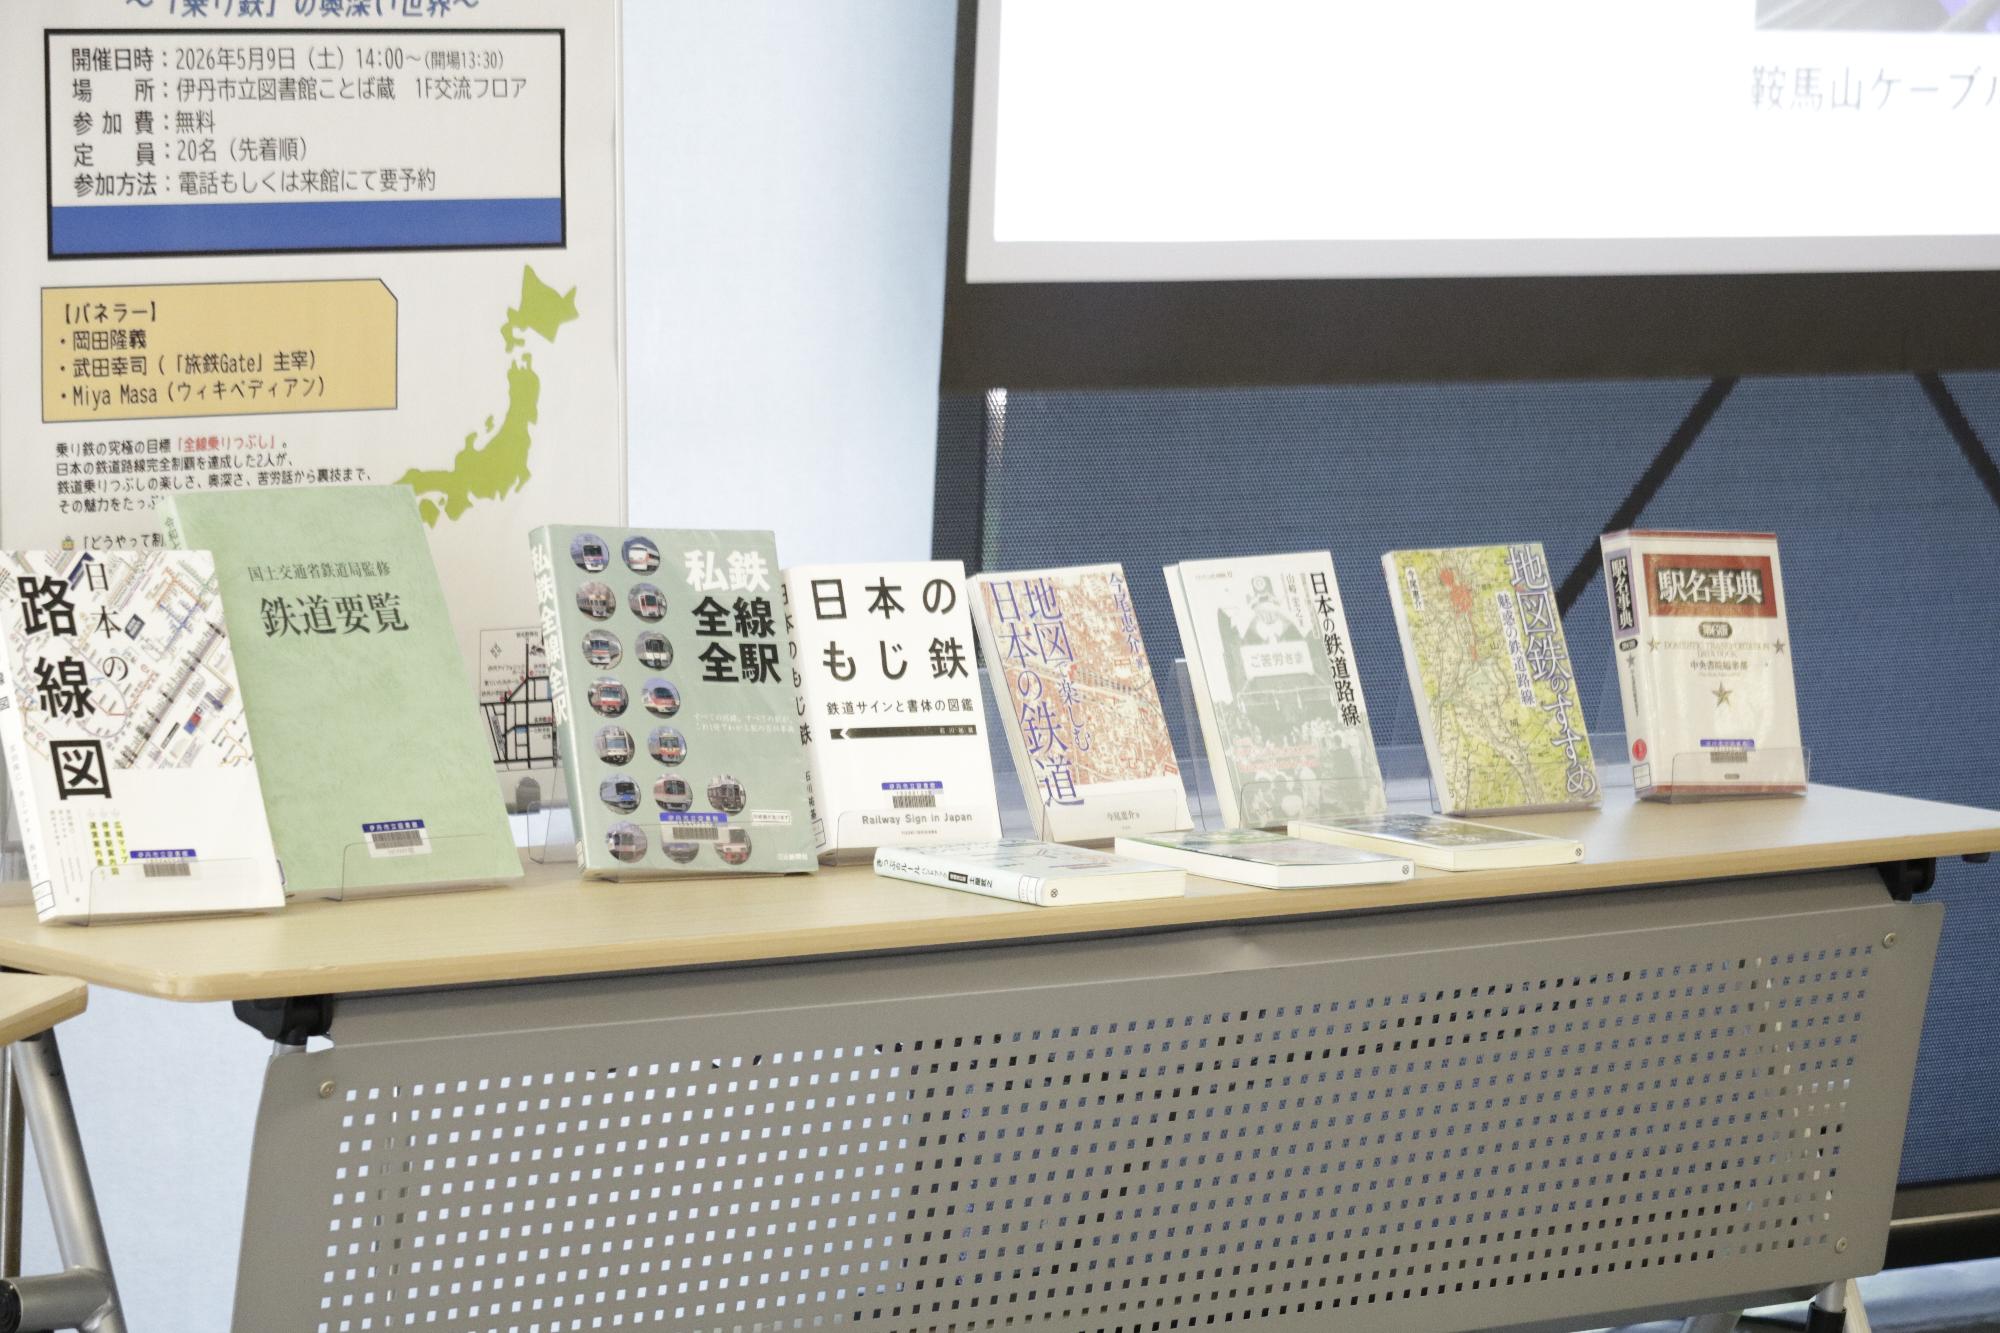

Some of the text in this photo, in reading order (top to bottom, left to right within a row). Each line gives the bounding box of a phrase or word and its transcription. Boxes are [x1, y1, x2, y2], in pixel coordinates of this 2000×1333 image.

[247, 560, 391, 582] 国土交通省鉄道局監修
[683, 550, 771, 593] 私鉄
[1610, 557, 1634, 630] 駅名事典
[1658, 569, 1763, 604] 駅名事典
[259, 592, 409, 638] 鉄道要覧
[691, 596, 776, 639] 全線
[810, 576, 957, 621] 日本の
[85, 563, 129, 681] 日本の
[700, 642, 782, 684] 全駅
[822, 637, 969, 683] もじ鉄
[1023, 577, 1091, 751] 地図で楽しむ
[1310, 572, 1362, 728] 日本の鉄道路線
[1505, 544, 1597, 798] 地図鉄のすすめ
[17, 575, 112, 800] 路線図
[826, 698, 974, 716] 鉄道サインと書体の図鑑
[990, 580, 1085, 807] 日本の鉄道
[862, 813, 973, 826] Railway Sign in Japan
